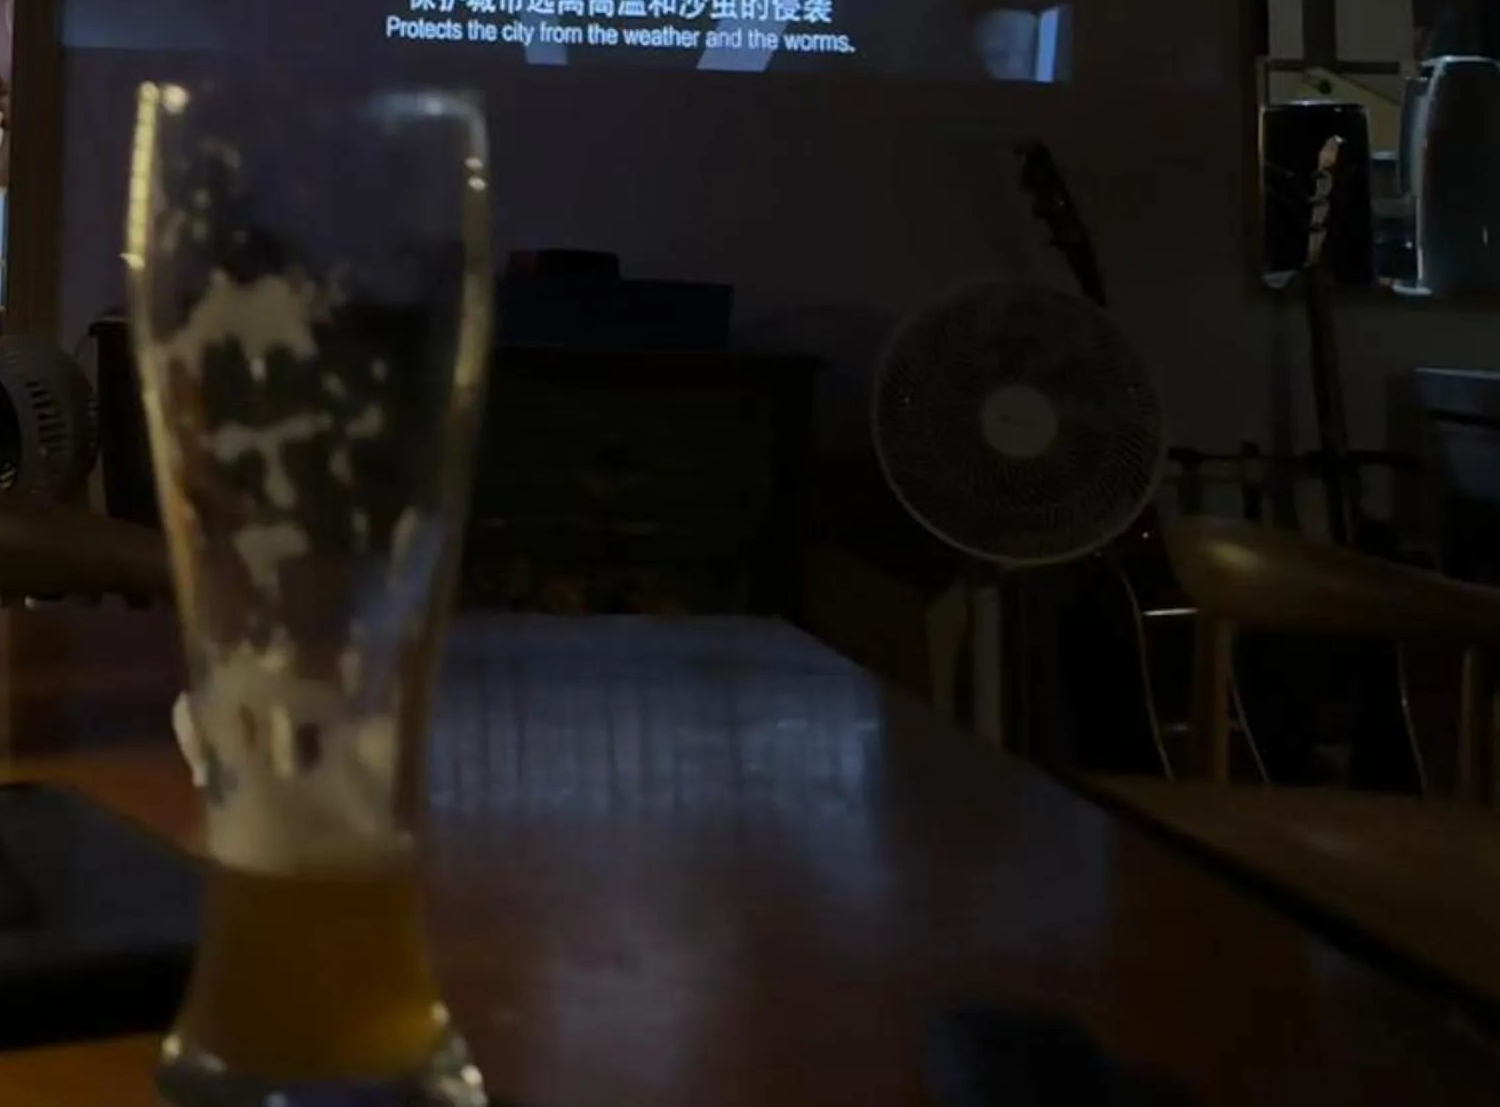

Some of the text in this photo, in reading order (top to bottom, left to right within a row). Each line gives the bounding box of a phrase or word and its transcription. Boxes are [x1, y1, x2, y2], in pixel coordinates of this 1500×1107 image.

[386, 15, 856, 54] Protects the city from the weather and the worms.
